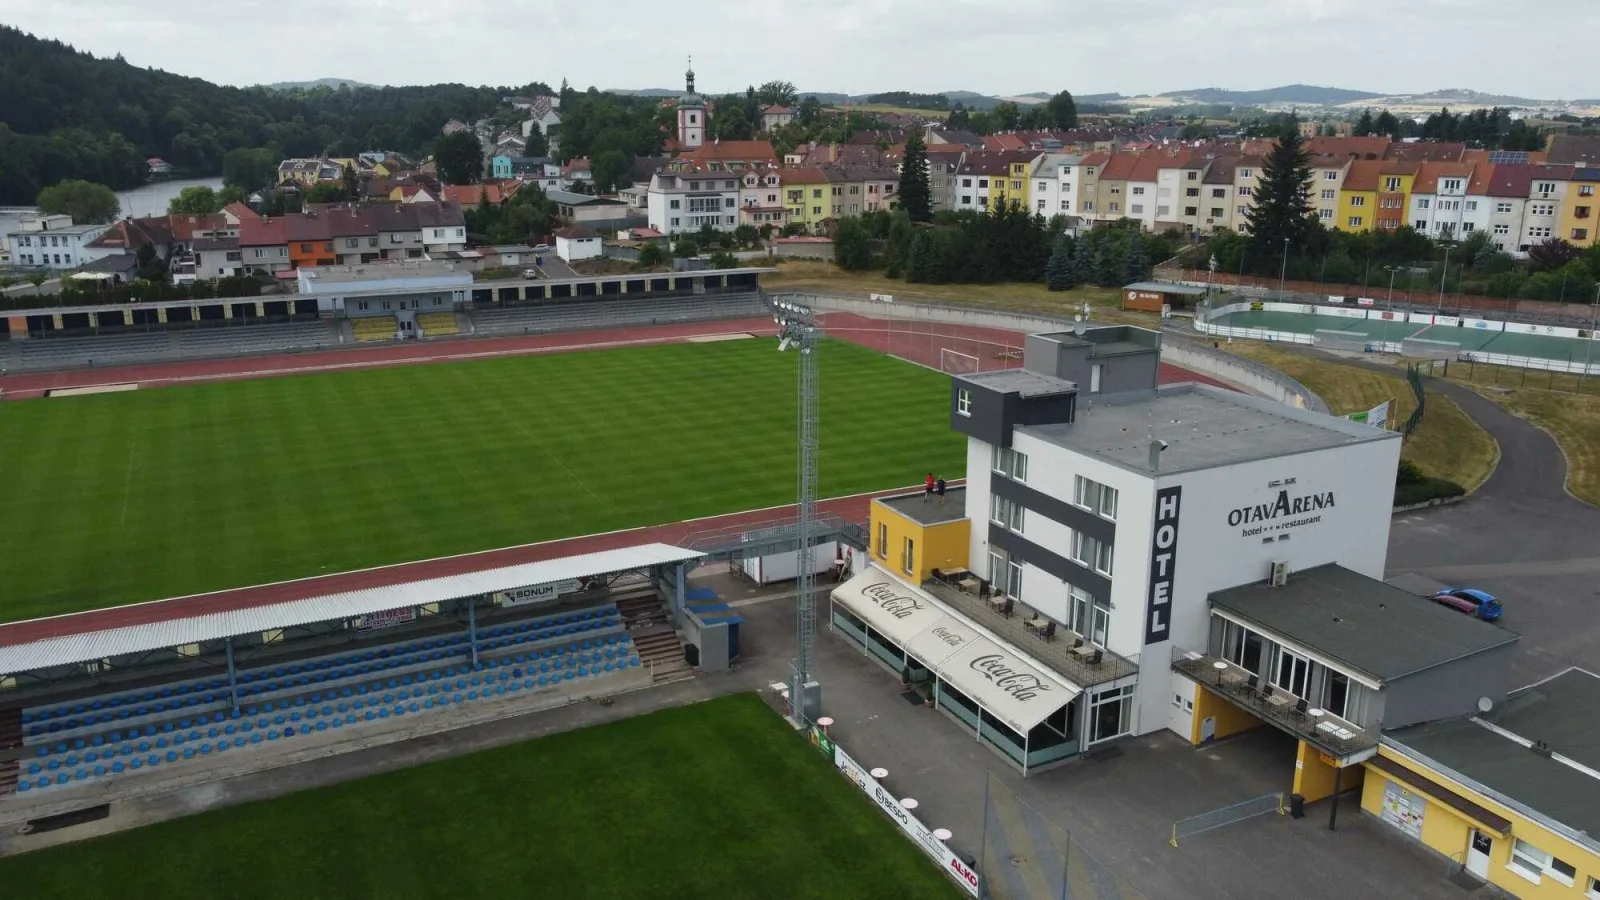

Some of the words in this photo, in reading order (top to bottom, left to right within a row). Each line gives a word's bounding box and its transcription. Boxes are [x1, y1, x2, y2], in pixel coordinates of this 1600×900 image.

[1241, 525, 1263, 538] hotel
[1280, 514, 1322, 530] restaurant
[1151, 494, 1177, 633] HOTEL
[516, 586, 554, 599] BONUM
[884, 797, 908, 825] BESPO
[950, 859, 978, 887] AL-KO
